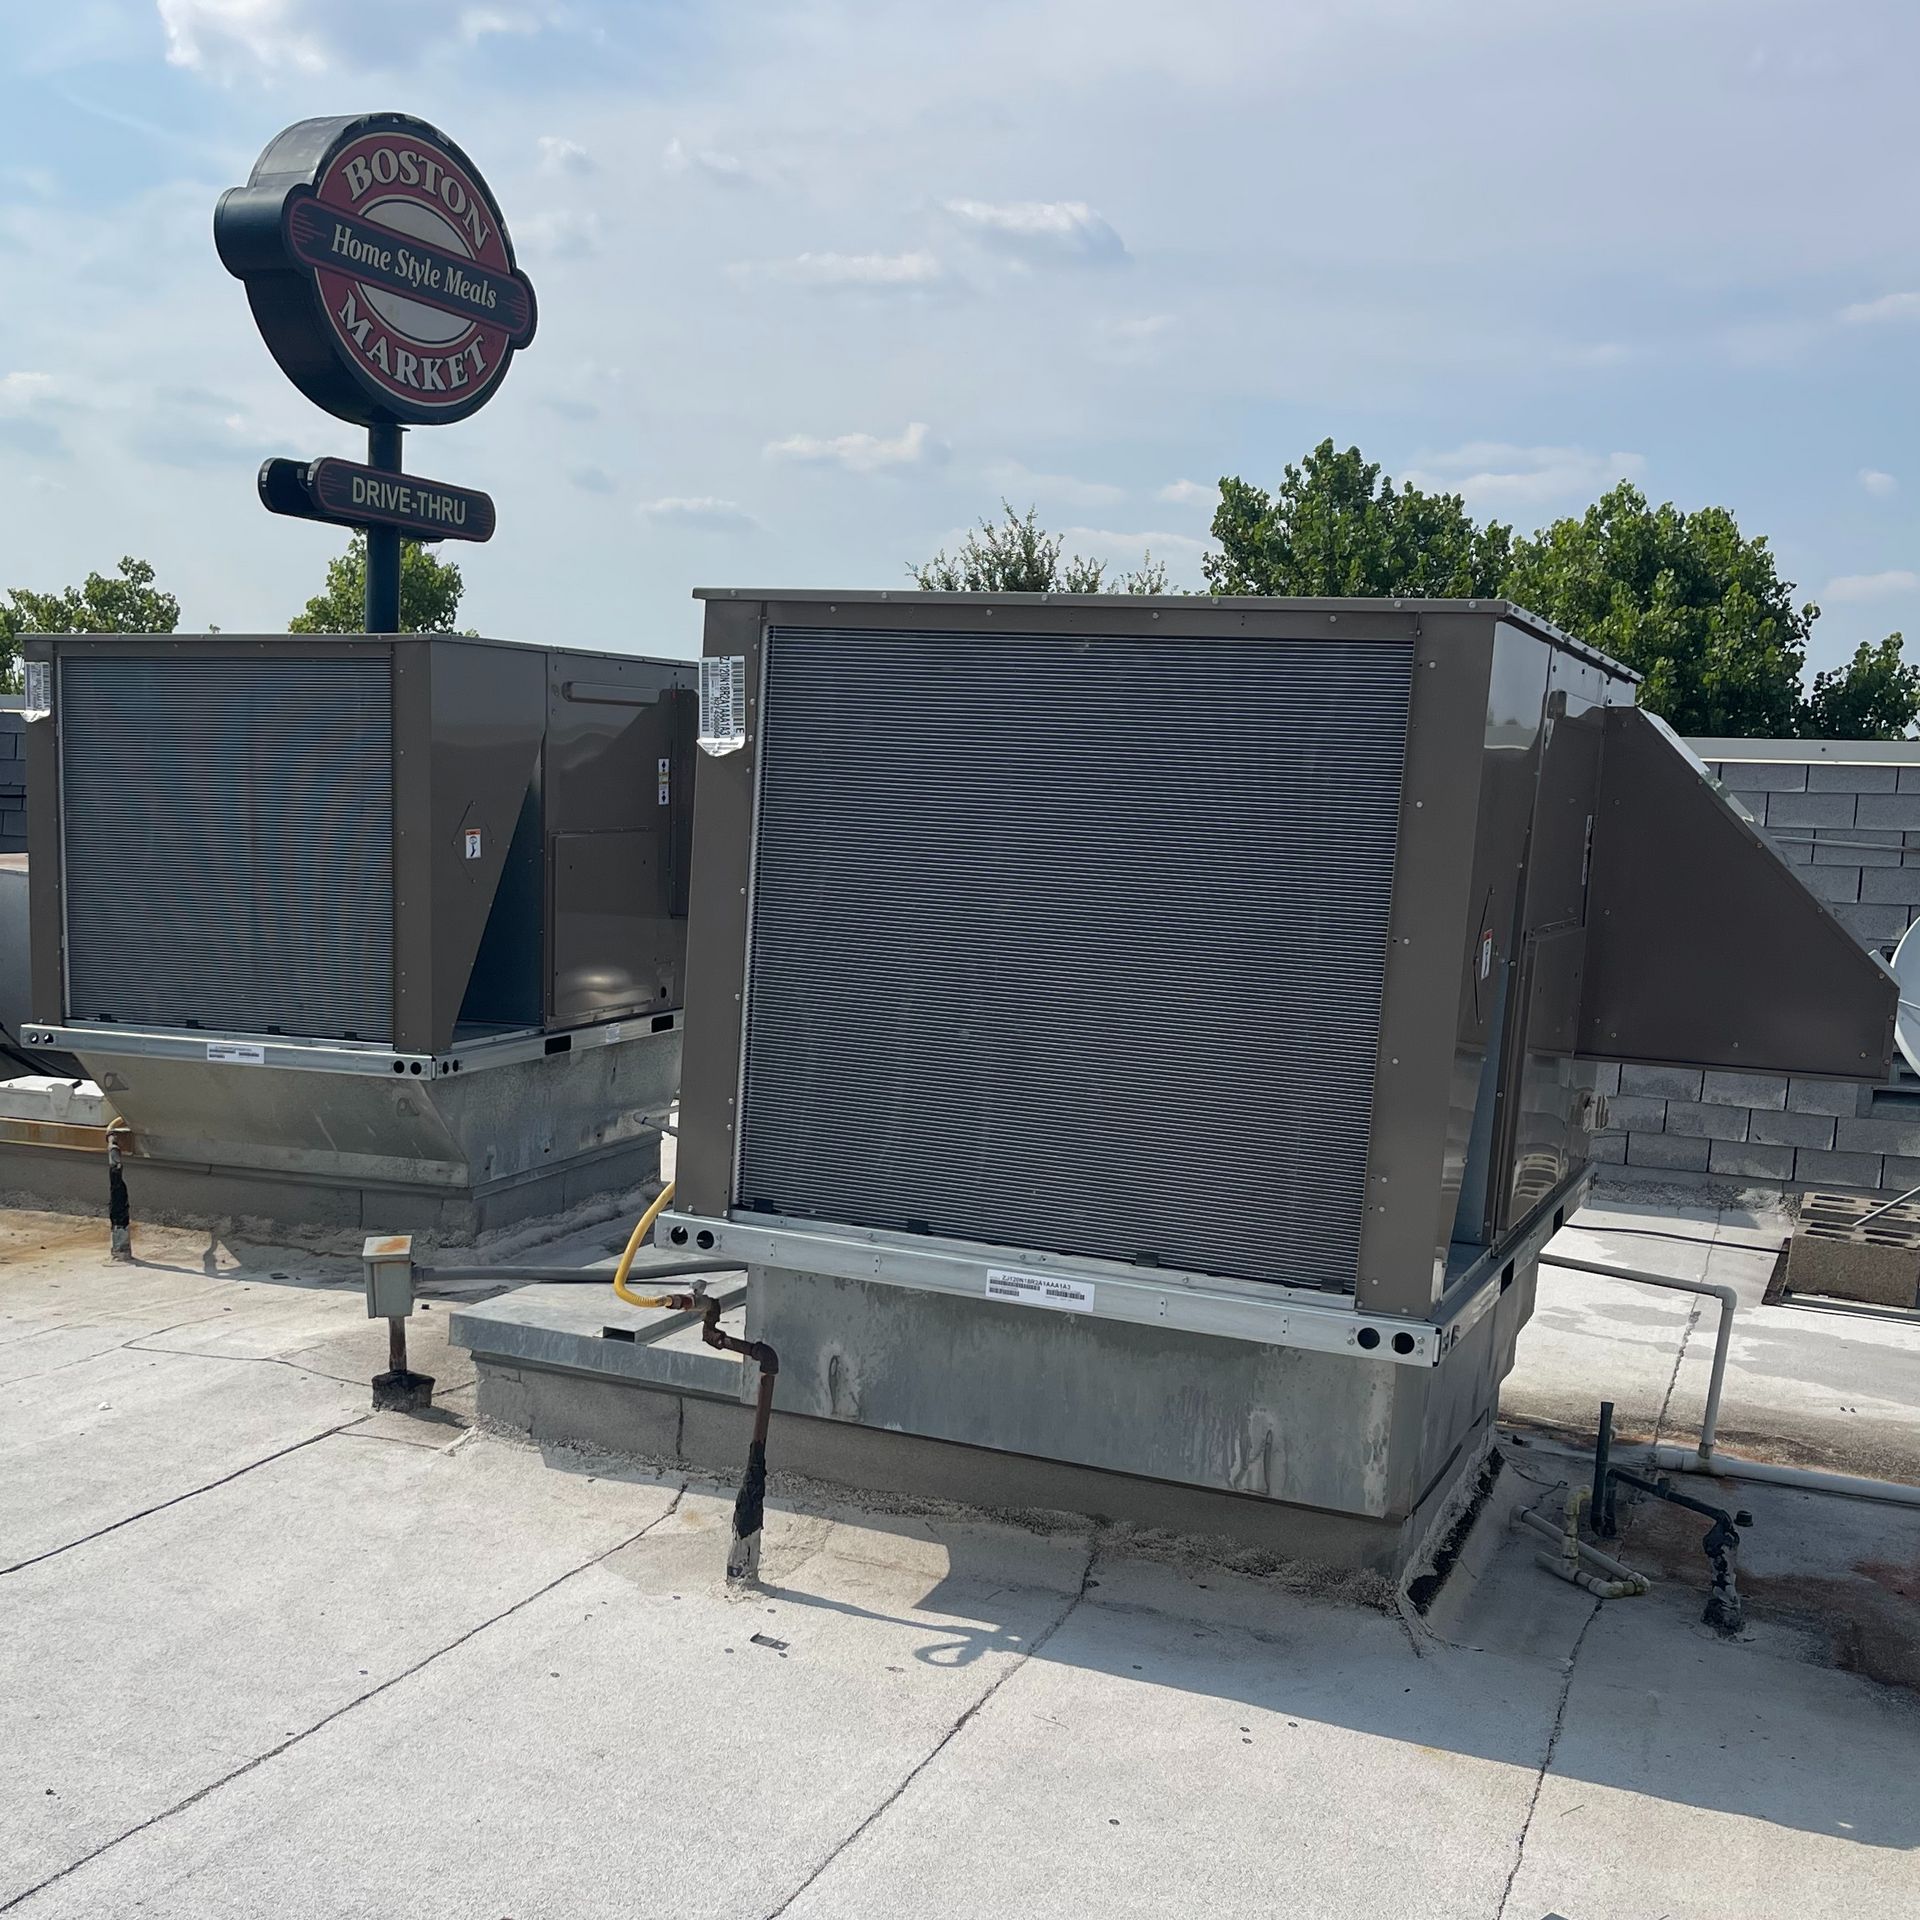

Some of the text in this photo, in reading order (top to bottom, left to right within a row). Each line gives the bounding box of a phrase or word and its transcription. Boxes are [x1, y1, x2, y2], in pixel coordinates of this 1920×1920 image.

[342, 148, 490, 249] BOSTON
[331, 223, 497, 309] Home Style Meals
[338, 290, 488, 392] MARKET
[352, 476, 466, 525] DRIVE-THRU
